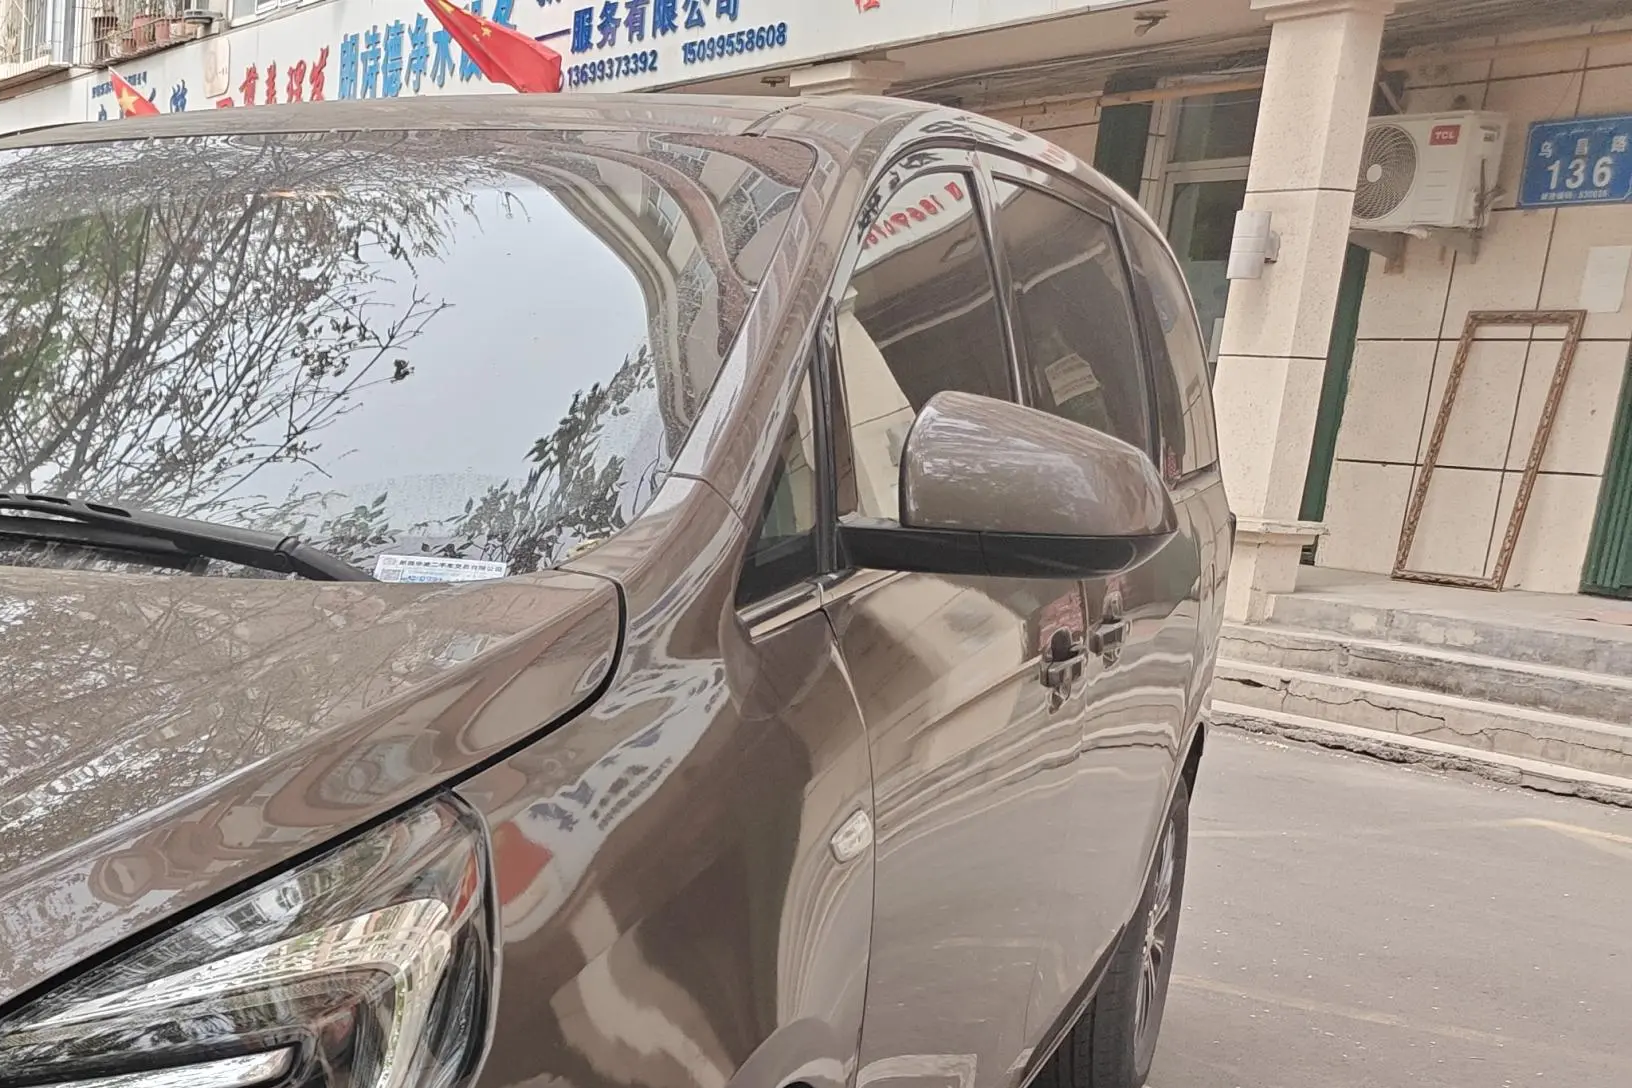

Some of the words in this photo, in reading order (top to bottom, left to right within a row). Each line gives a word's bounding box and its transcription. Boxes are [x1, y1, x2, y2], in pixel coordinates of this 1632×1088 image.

[568, 49, 658, 87] 13699373392
[682, 22, 787, 64] 15099558608
[1434, 131, 1456, 140] TCL
[1547, 156, 1614, 190] 136
